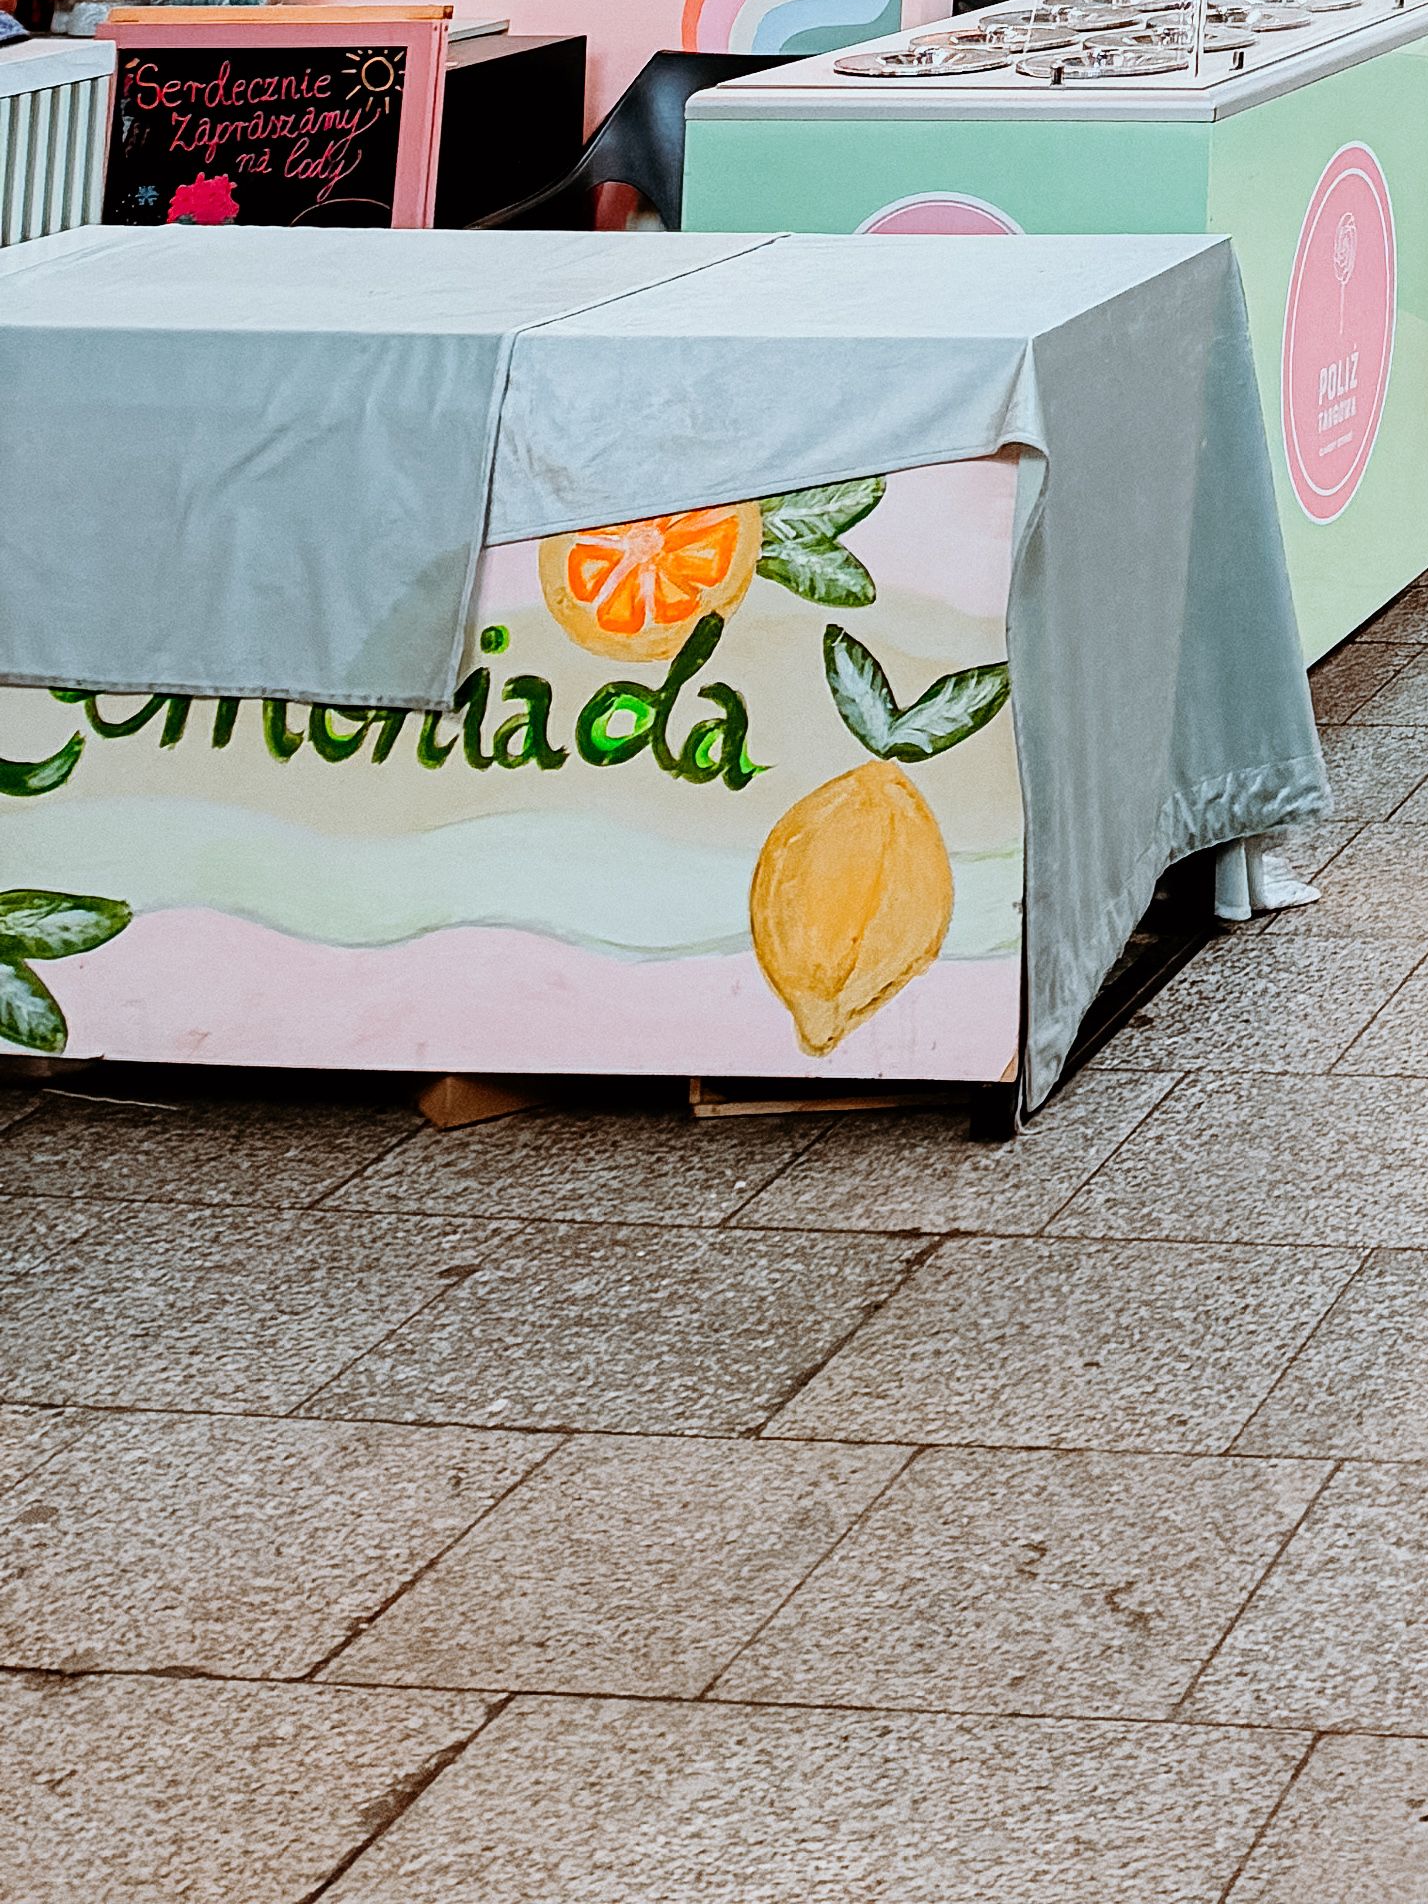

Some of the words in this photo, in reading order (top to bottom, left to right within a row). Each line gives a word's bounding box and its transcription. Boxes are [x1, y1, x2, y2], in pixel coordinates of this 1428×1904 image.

[136, 60, 331, 109] Serdecznie
[170, 107, 381, 164] Zapraszamy
[236, 148, 272, 173] na
[284, 137, 361, 203] lody
[1319, 343, 1359, 405] POLIŻ
[0, 612, 773, 796] emoniada
